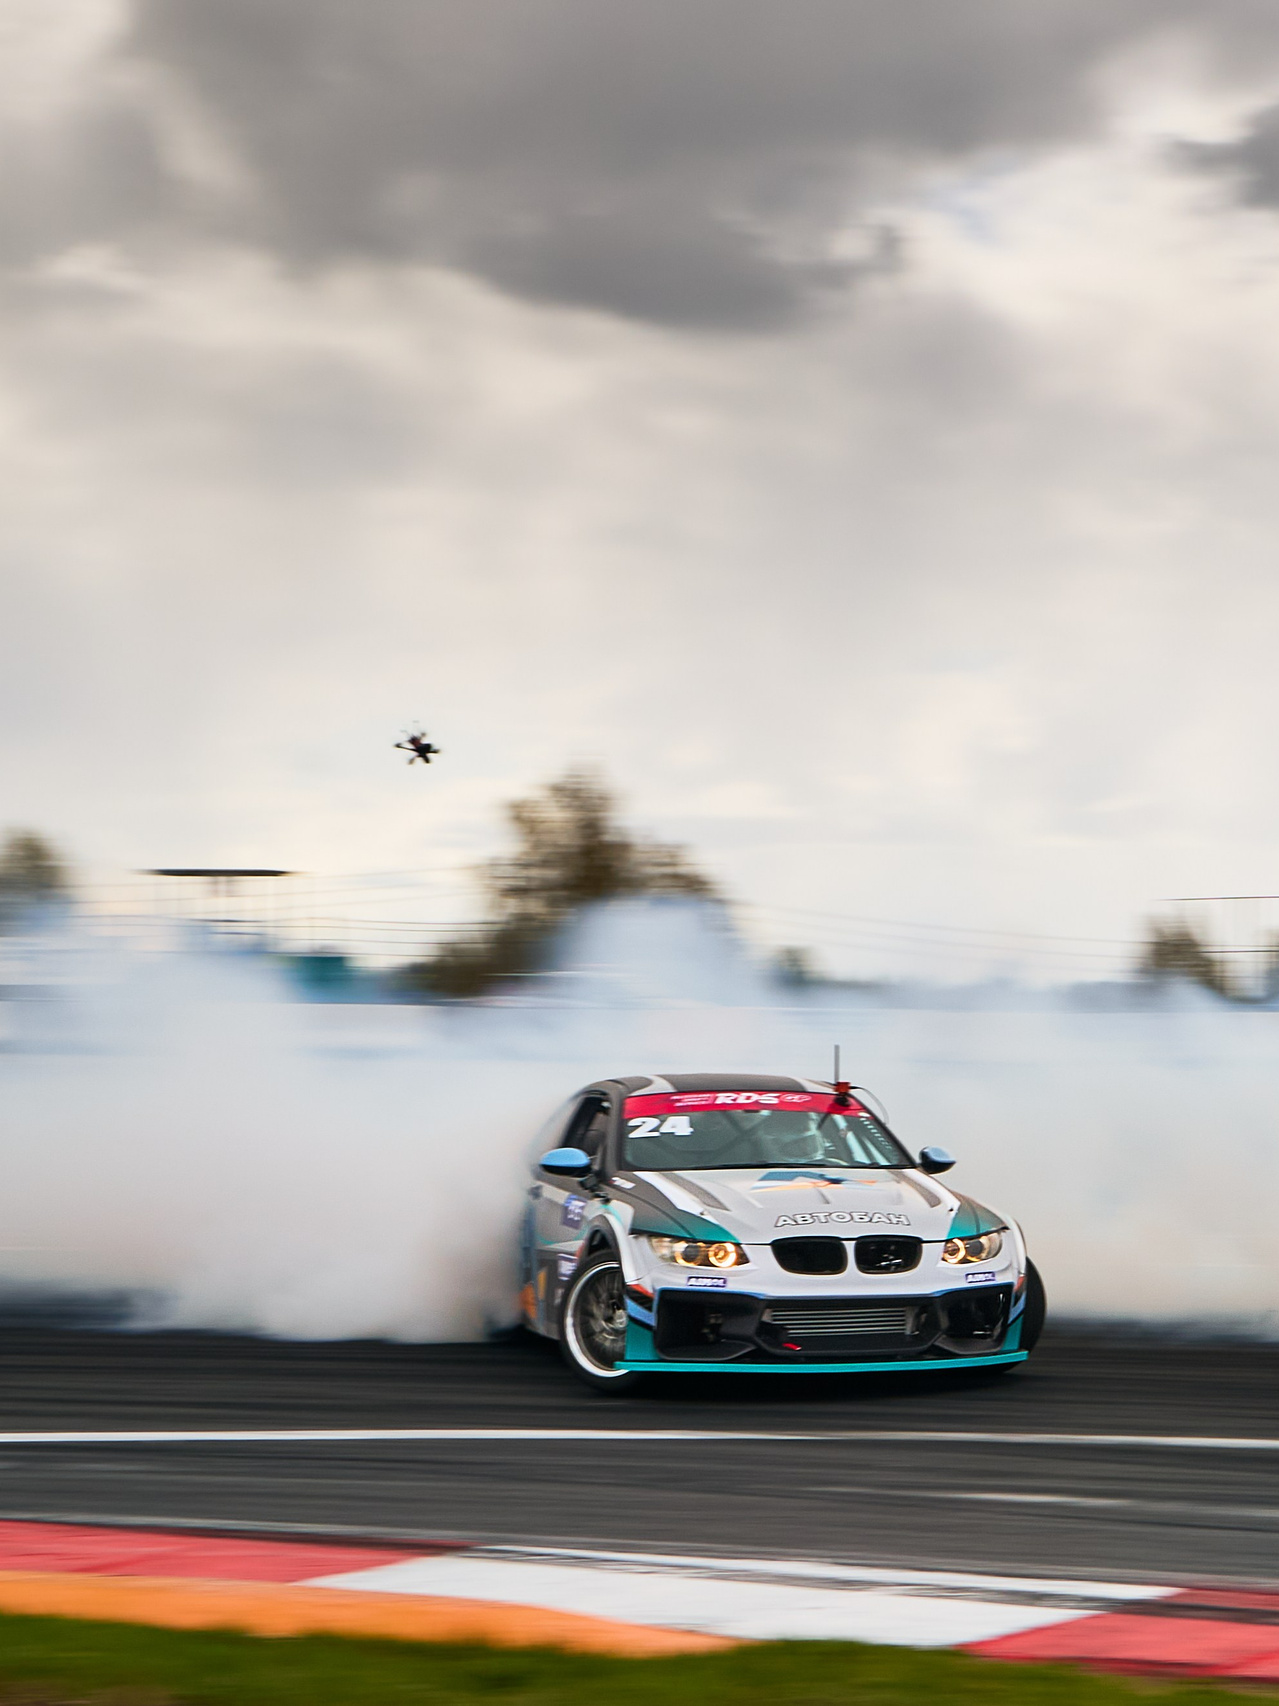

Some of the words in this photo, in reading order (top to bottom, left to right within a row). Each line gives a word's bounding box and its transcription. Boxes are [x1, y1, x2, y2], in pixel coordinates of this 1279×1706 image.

[715, 1093, 781, 1104] RDS
[627, 1115, 694, 1138] 24
[774, 1211, 911, 1227] АВТОБАН
